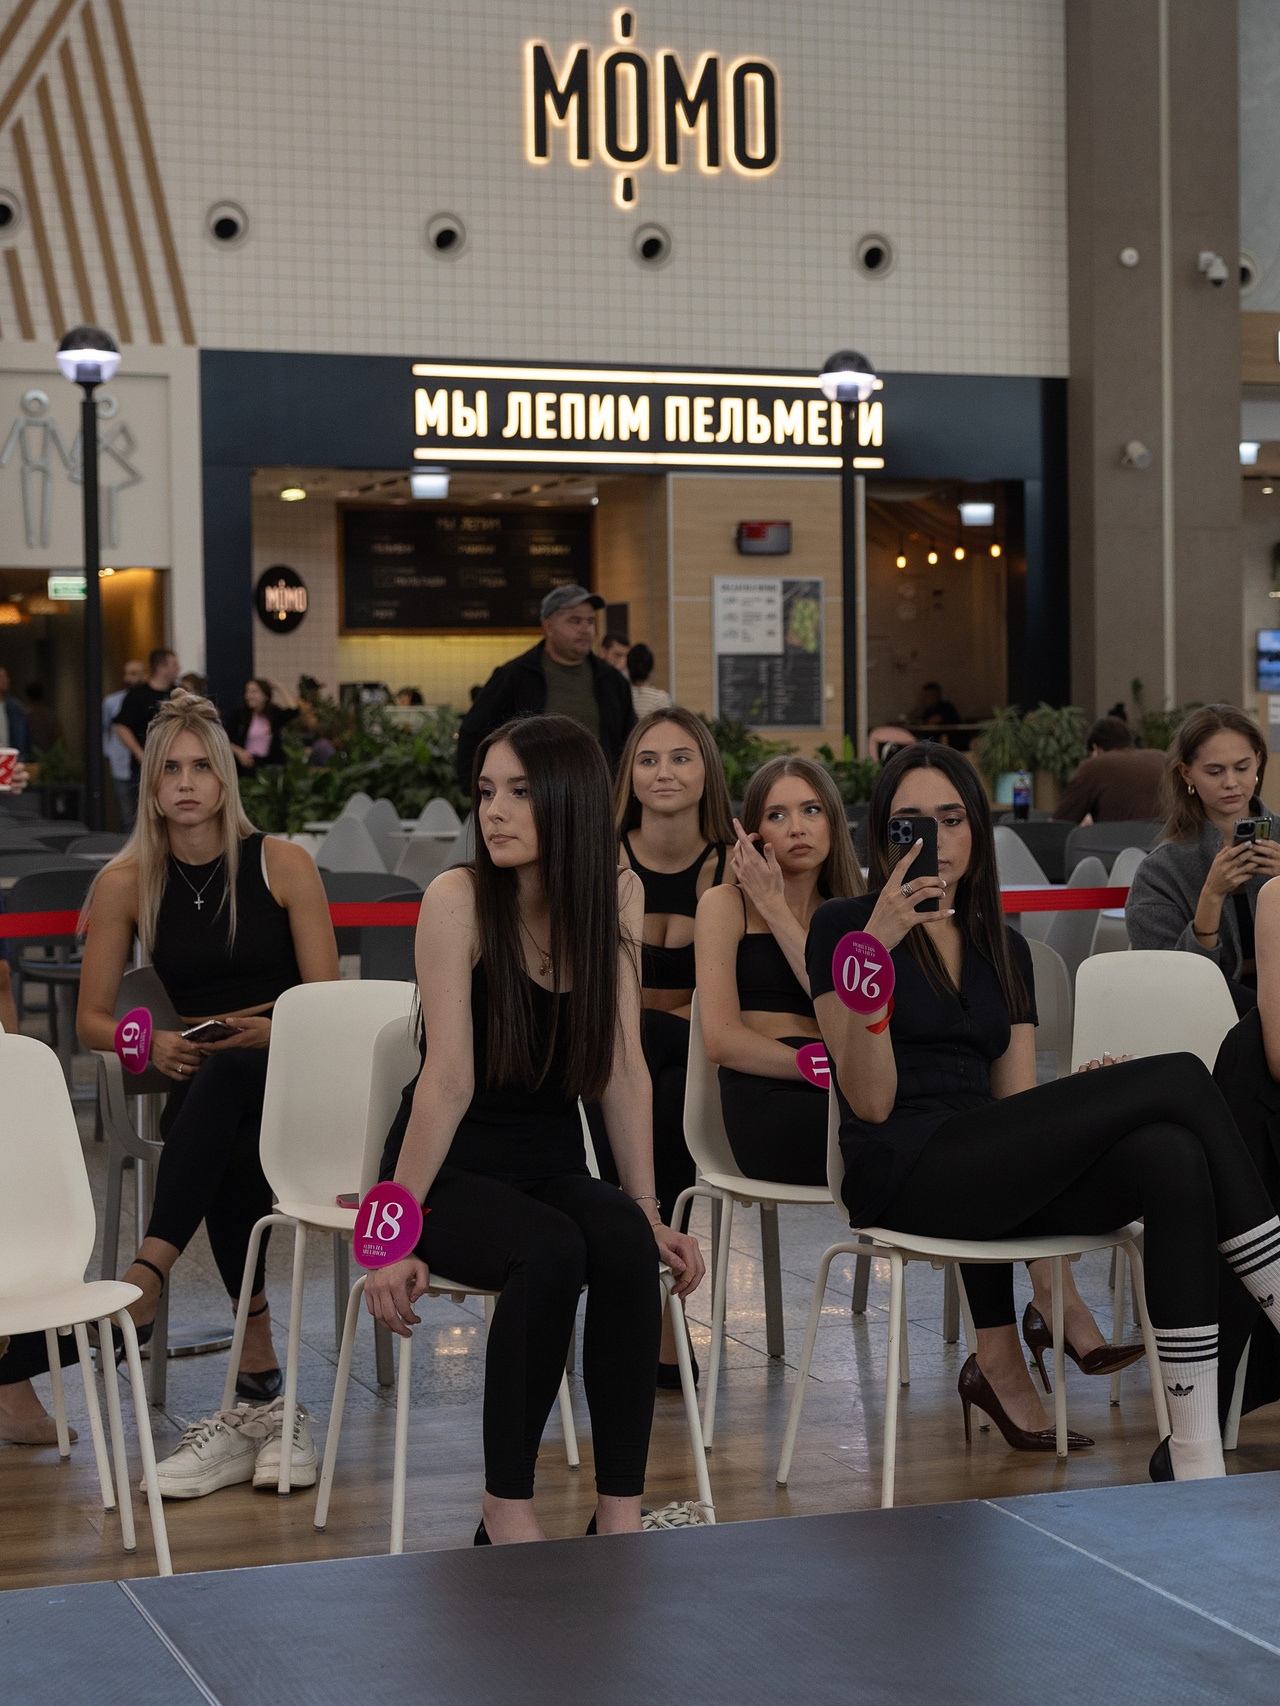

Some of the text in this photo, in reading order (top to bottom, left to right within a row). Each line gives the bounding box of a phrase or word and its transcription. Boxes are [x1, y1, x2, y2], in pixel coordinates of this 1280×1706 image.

[415, 388, 488, 438] МЫ
[502, 391, 650, 442] ЛЕПИМ
[842, 955, 883, 998] 20
[122, 1022, 140, 1059] 19
[362, 1200, 404, 1241] 18
